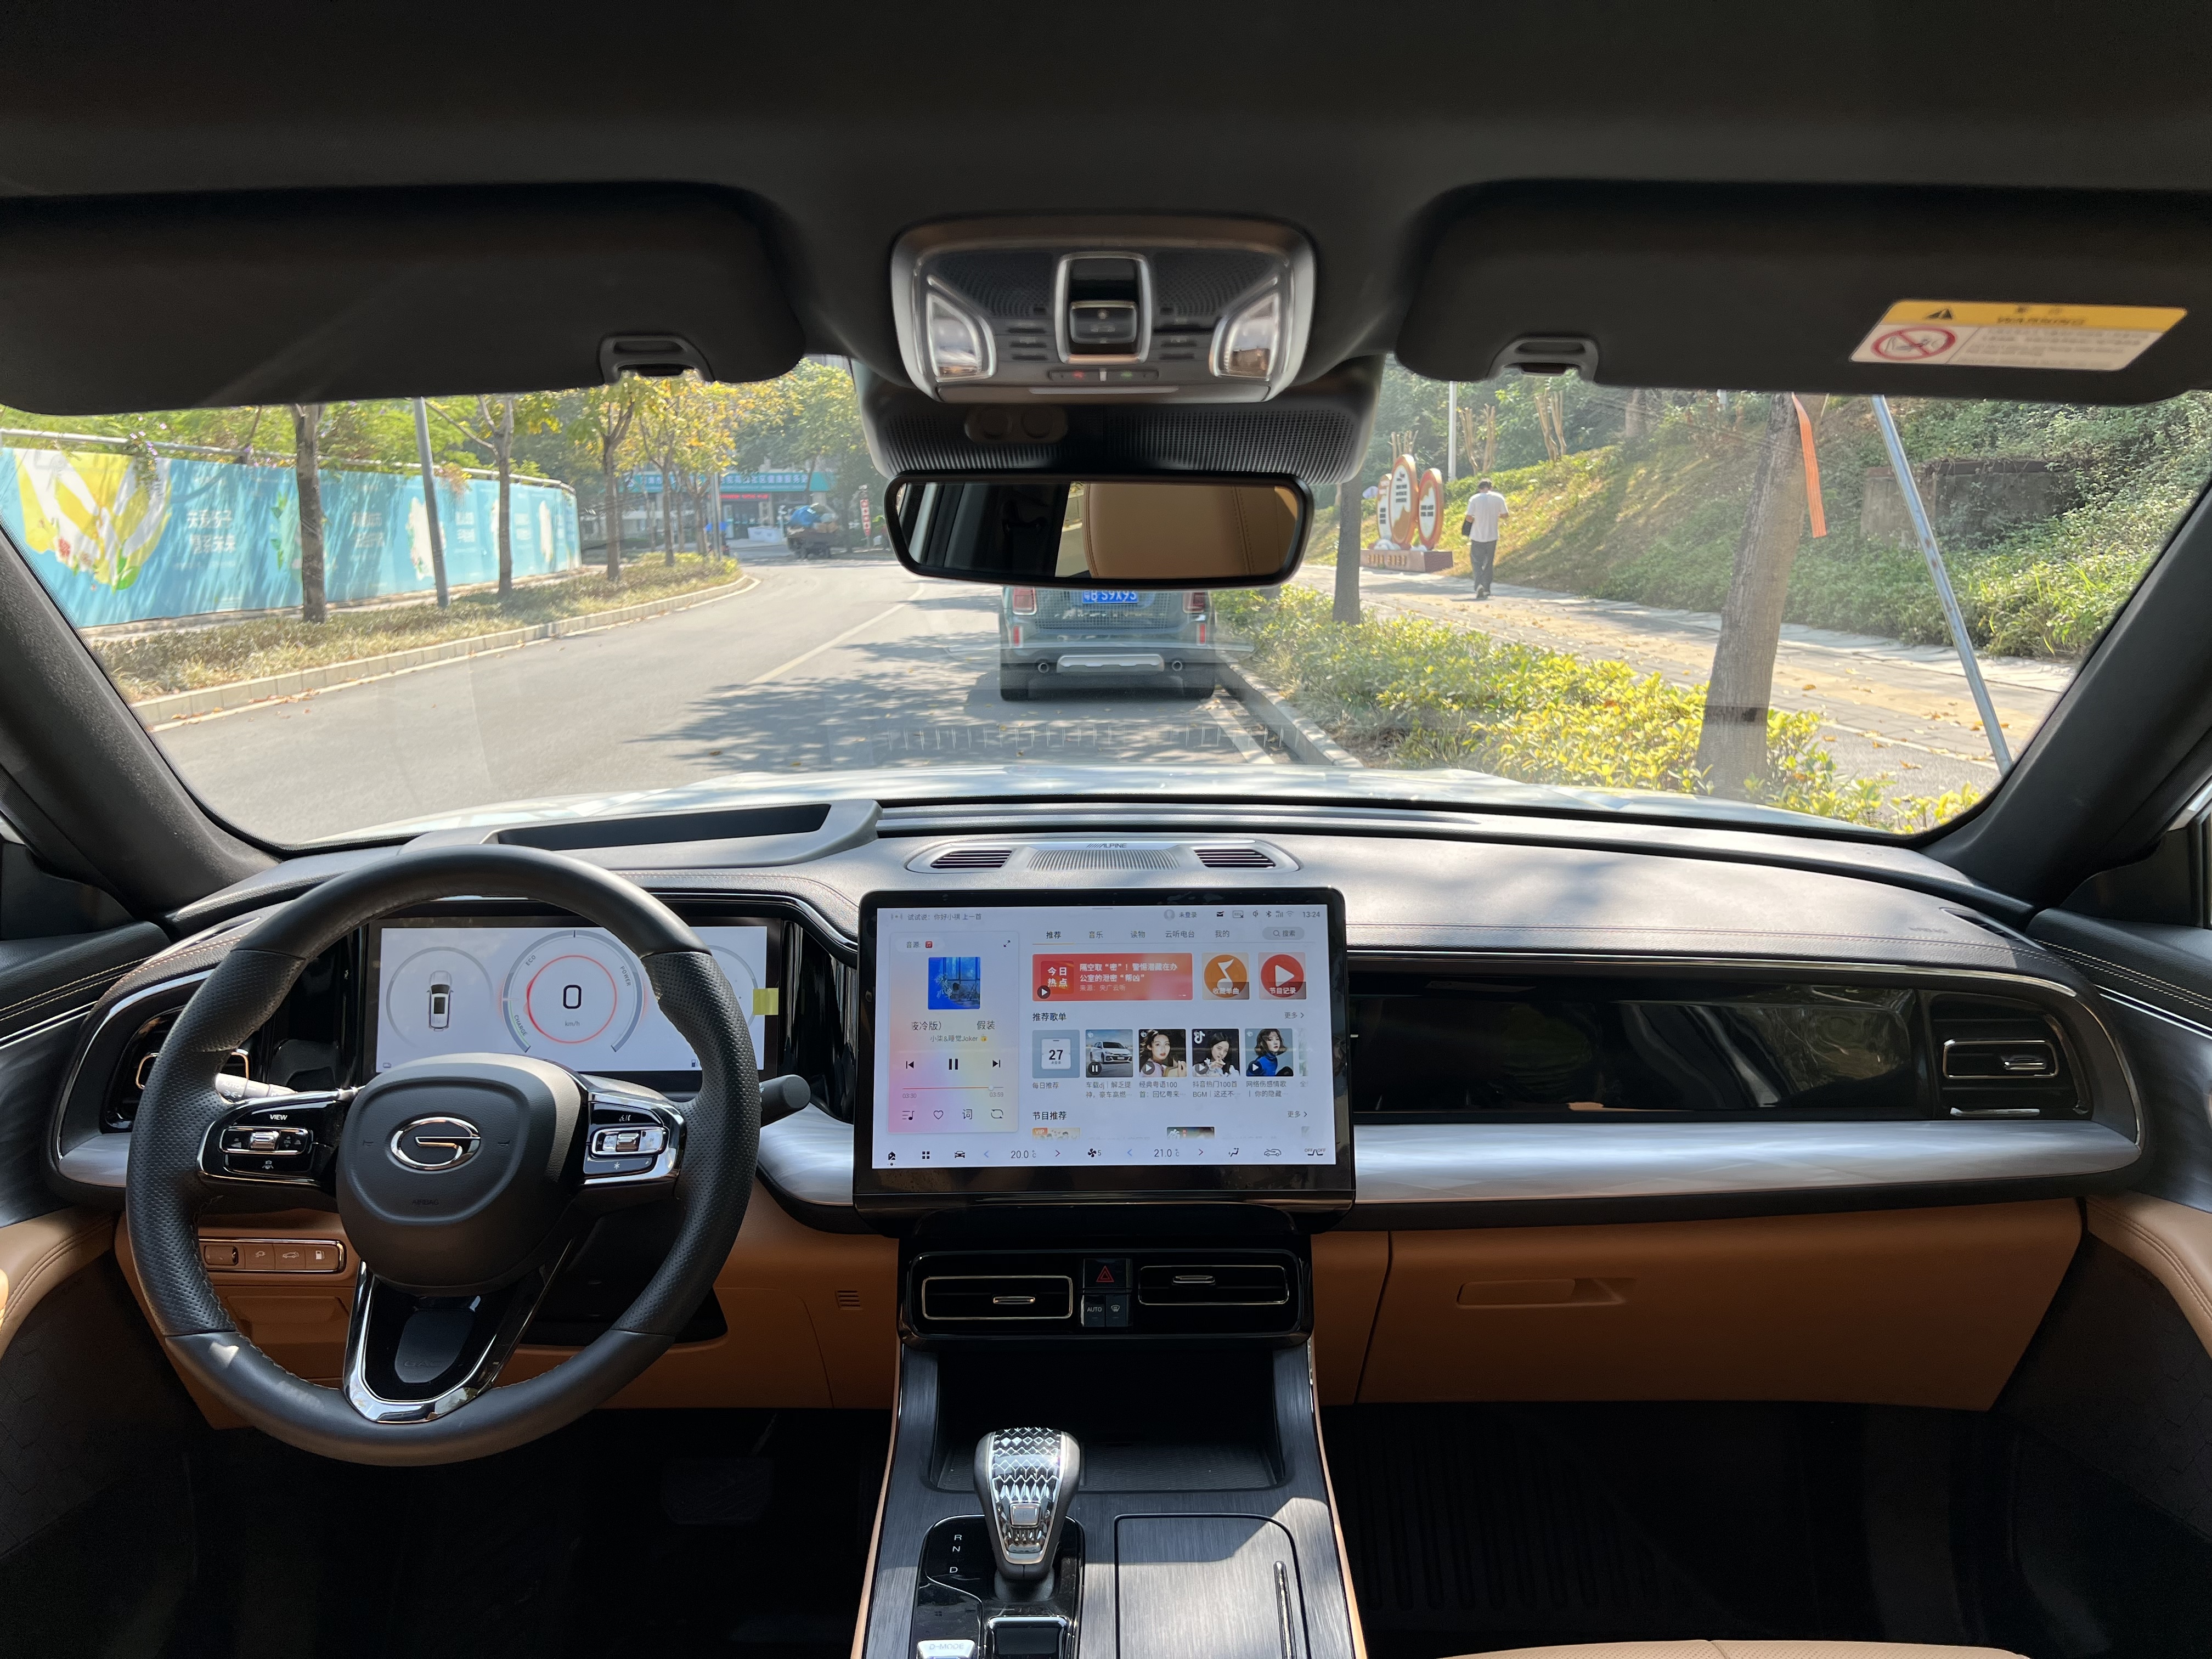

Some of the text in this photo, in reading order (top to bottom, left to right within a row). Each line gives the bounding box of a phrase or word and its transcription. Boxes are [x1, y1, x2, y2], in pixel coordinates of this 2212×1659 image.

[1046, 931, 1062, 939] 推荐
[526, 955, 536, 966] ECO
[620, 966, 631, 986] POWER
[1047, 966, 1067, 976] 今日
[1047, 978, 1068, 987] 热点
[563, 984, 582, 1009] 0
[1032, 1012, 1066, 1022] 推荐歌单
[514, 1014, 528, 1037] CHARGE
[977, 1020, 995, 1030] 假装
[1048, 1049, 1063, 1060] 27
[962, 1109, 973, 1120] 词
[1032, 1111, 1067, 1120] 节目推荐
[1011, 1150, 1029, 1159] 20.0
[1154, 1149, 1172, 1157] 21.0
